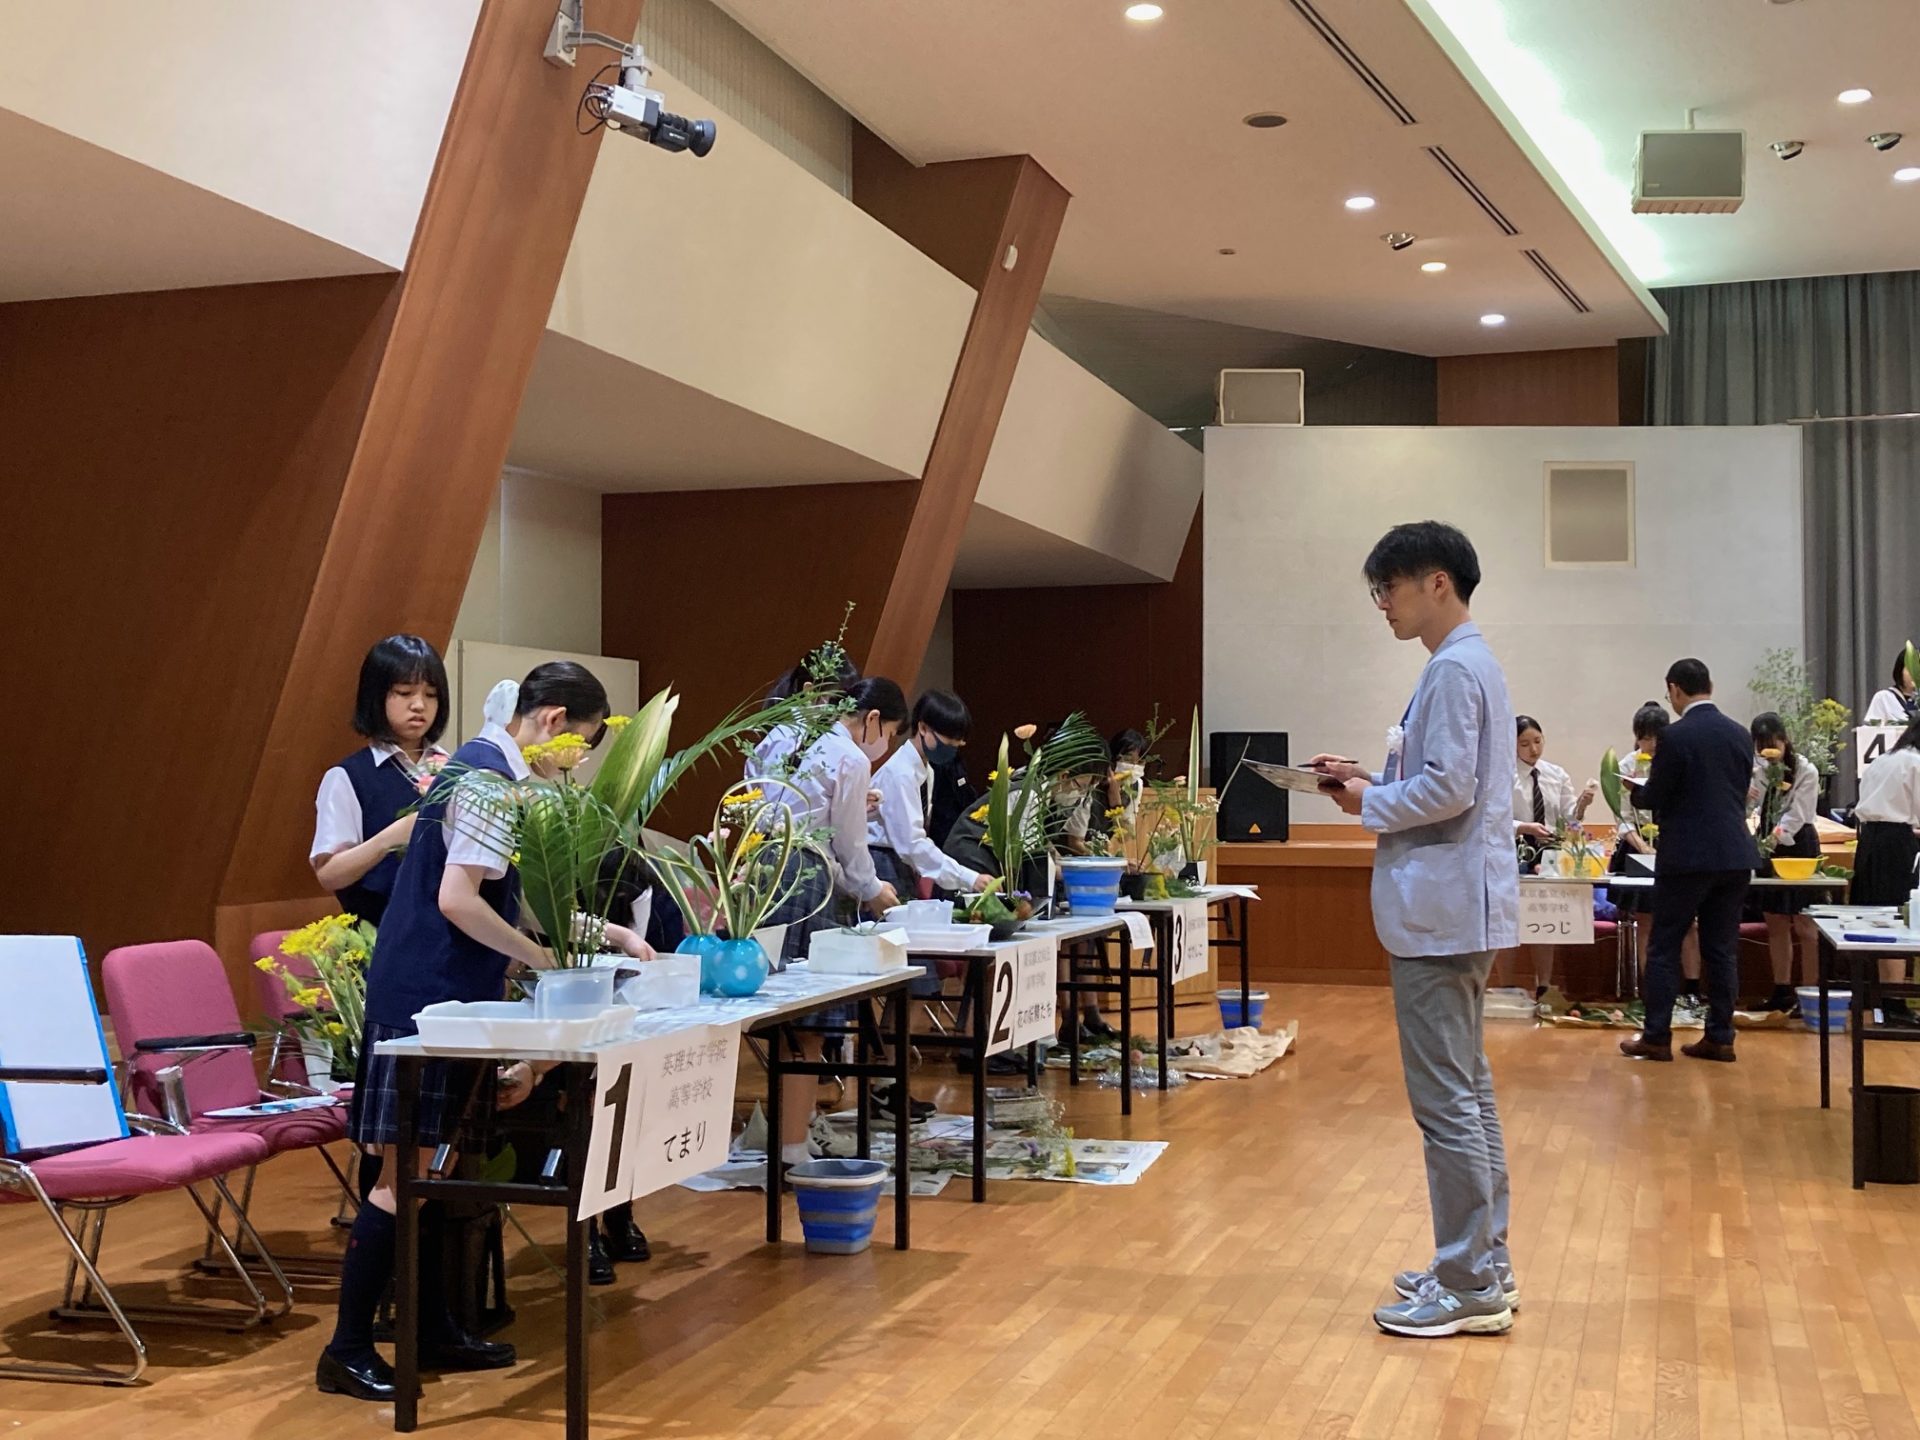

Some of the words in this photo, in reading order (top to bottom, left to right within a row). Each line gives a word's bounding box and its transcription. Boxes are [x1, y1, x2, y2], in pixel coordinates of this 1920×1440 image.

[1863, 733, 1886, 764] 4
[1174, 914, 1183, 975] 3
[1526, 920, 1572, 935] つつじ
[991, 960, 1014, 1046] 2
[660, 1038, 728, 1078] 英理女子学院
[667, 1078, 714, 1110] 高等学校
[603, 1062, 633, 1193] 1
[663, 1120, 707, 1163] てまり
[1438, 1294, 1464, 1313] N
